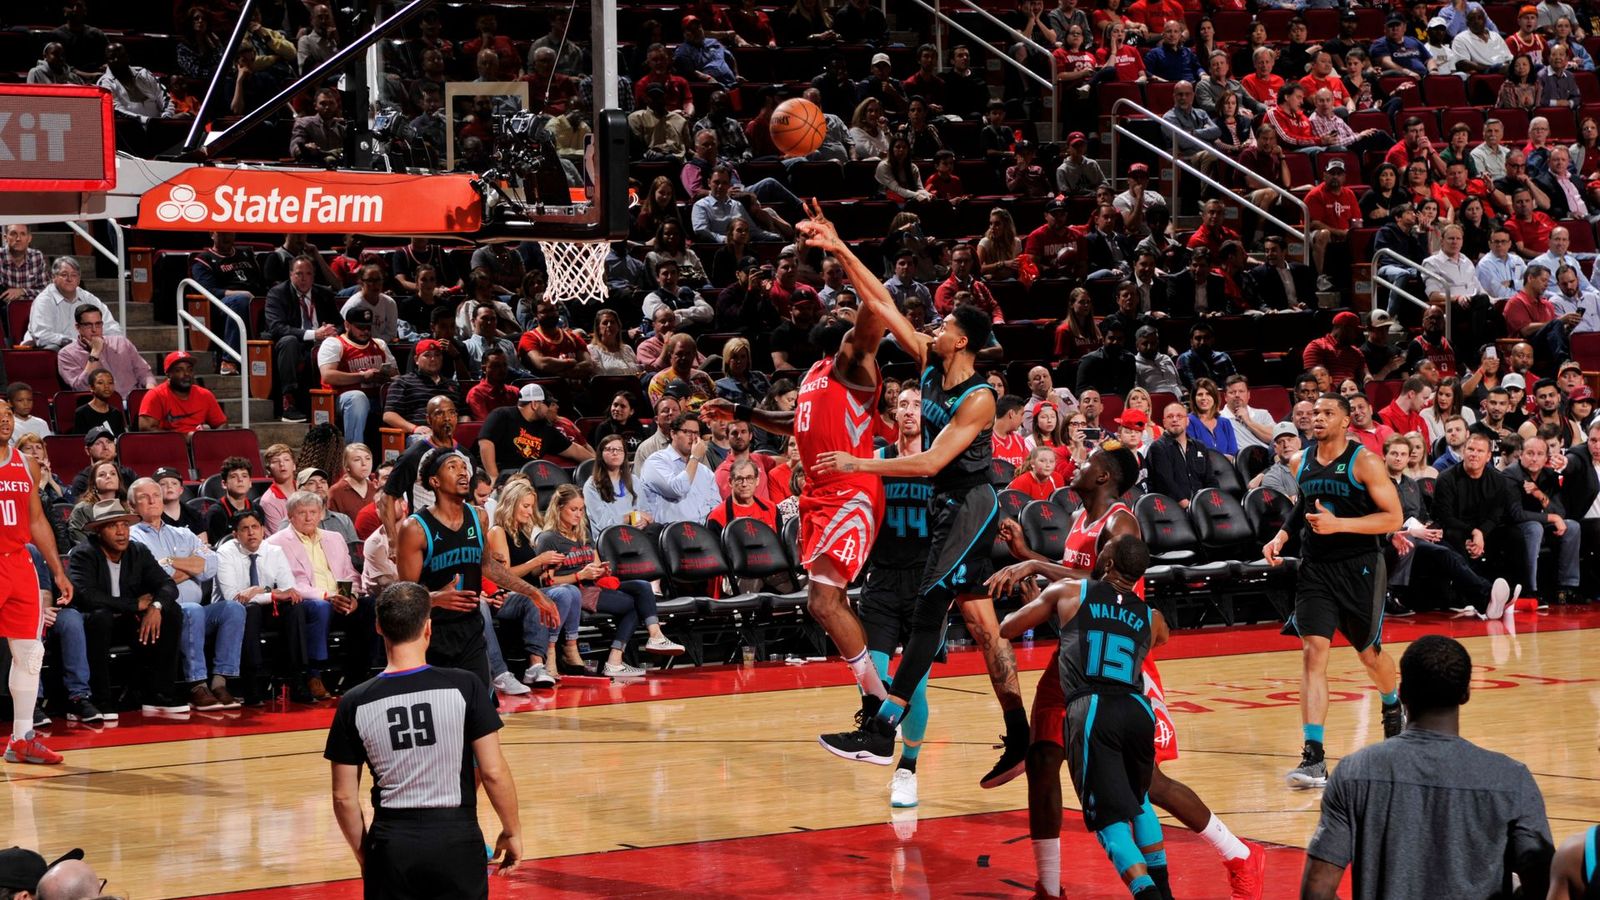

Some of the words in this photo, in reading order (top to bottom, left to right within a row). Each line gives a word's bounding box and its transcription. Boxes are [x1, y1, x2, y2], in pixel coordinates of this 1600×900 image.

[798, 401, 812, 432] 13
[886, 506, 929, 538] 44
[431, 548, 461, 573] BUZZ
[1089, 603, 1144, 632] WALKER
[1085, 629, 1136, 685] 15
[386, 702, 437, 752] 29
